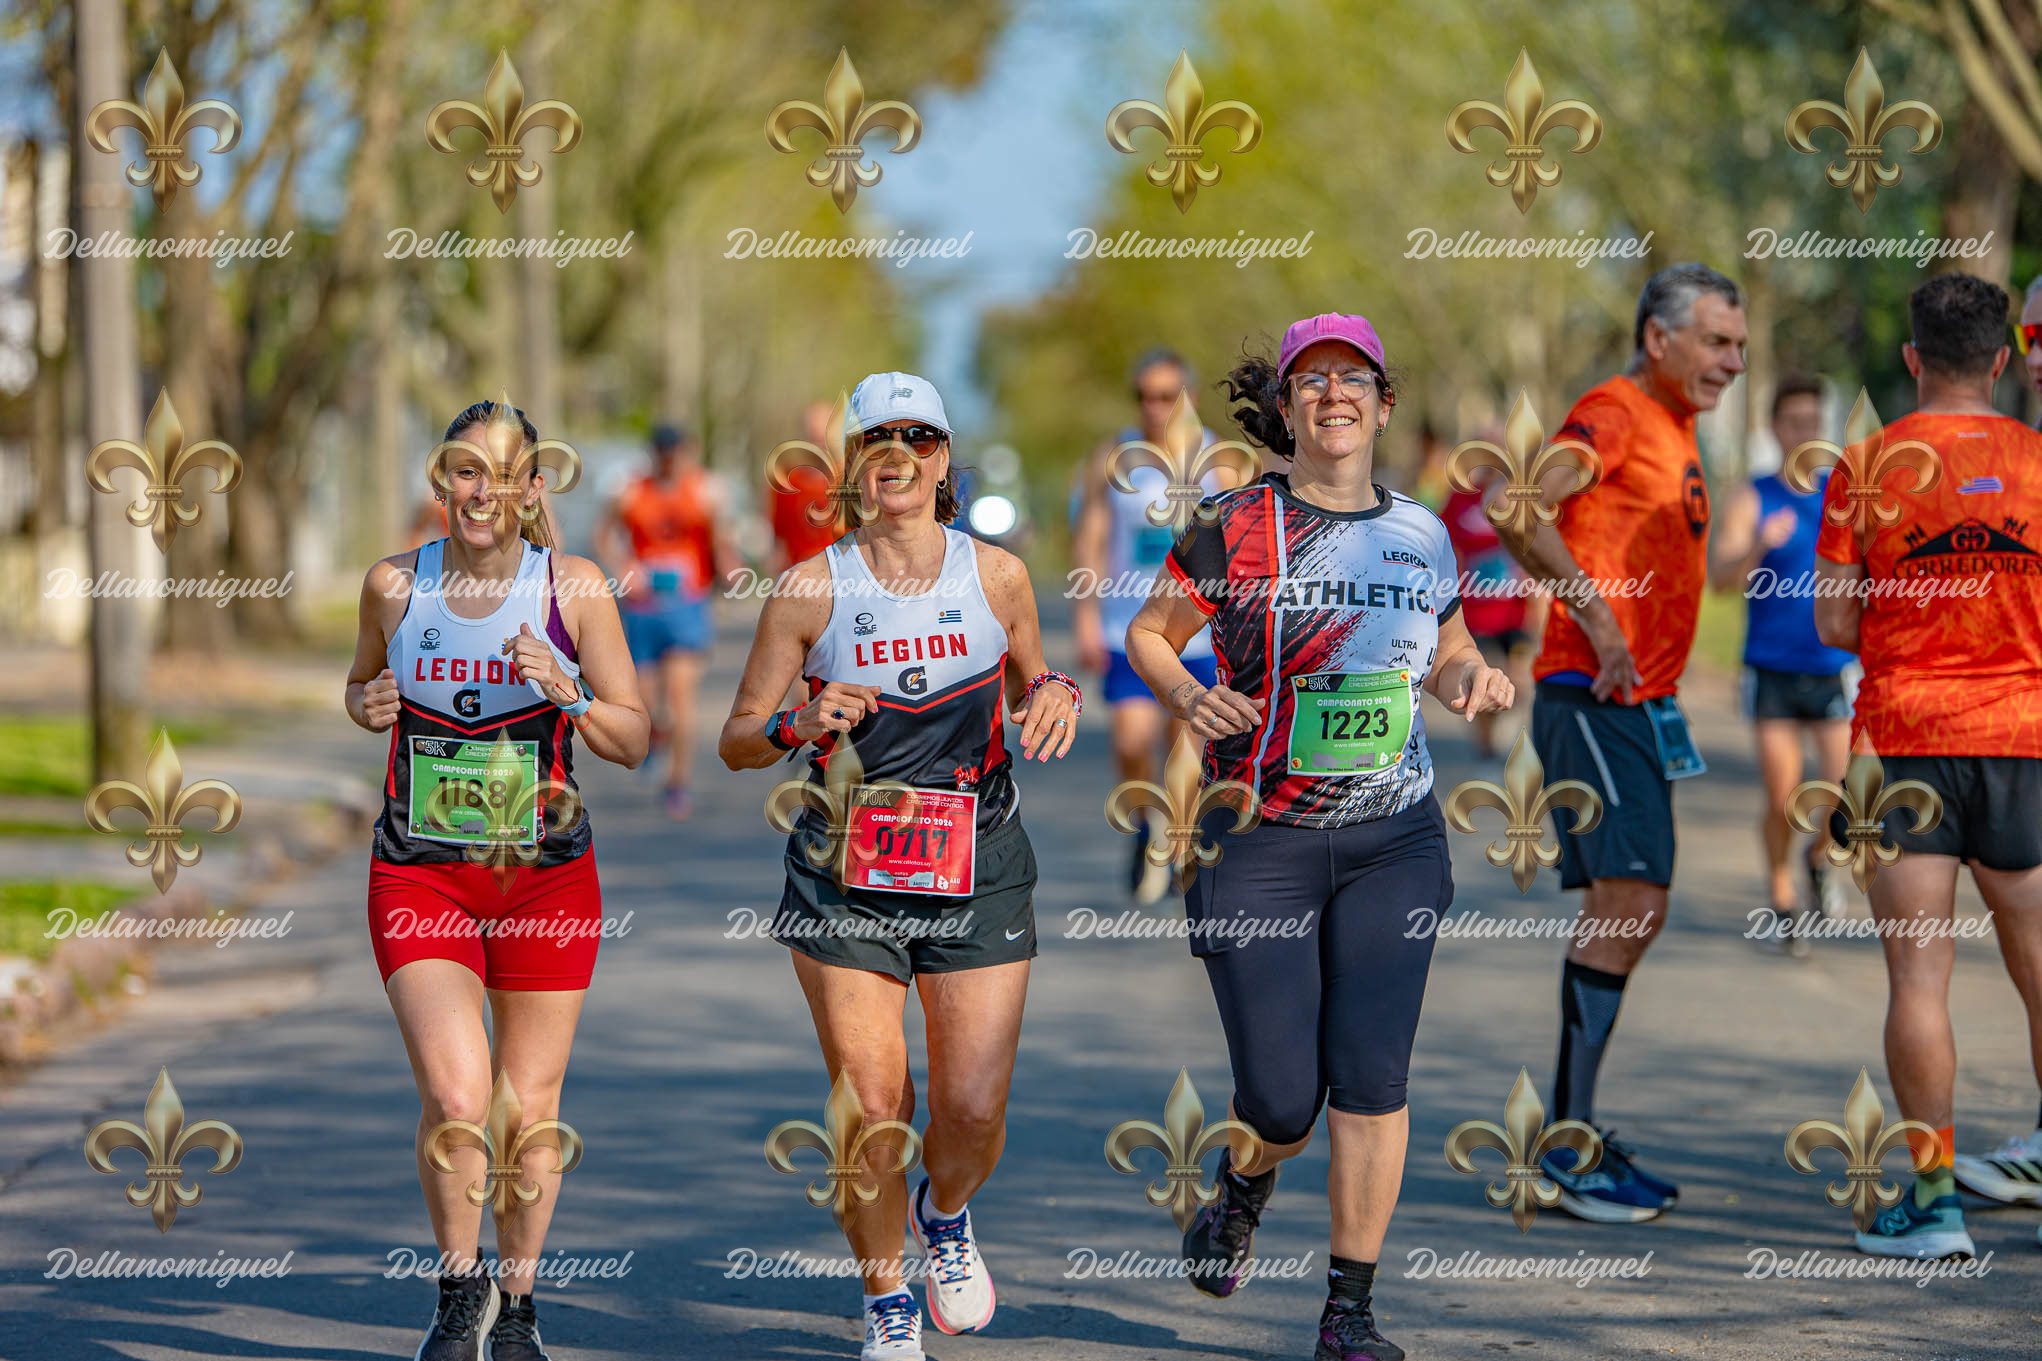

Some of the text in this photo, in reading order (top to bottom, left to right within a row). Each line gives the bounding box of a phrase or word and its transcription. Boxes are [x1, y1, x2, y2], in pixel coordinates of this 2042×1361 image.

[855, 633, 967, 667] LEGION
[1391, 638, 1417, 650] ULTRA
[1307, 675, 1331, 690] 5K
[1316, 698, 1373, 706] CAMPEONATO
[1321, 708, 1390, 740] 1223
[424, 740, 447, 756] 5K
[432, 763, 514, 776] CAMPEONATO 2026
[439, 776, 507, 809] 1188
[860, 790, 892, 807] 10K
[871, 814, 953, 827] CAMPEONATO 2026
[876, 826, 949, 859] 0717
